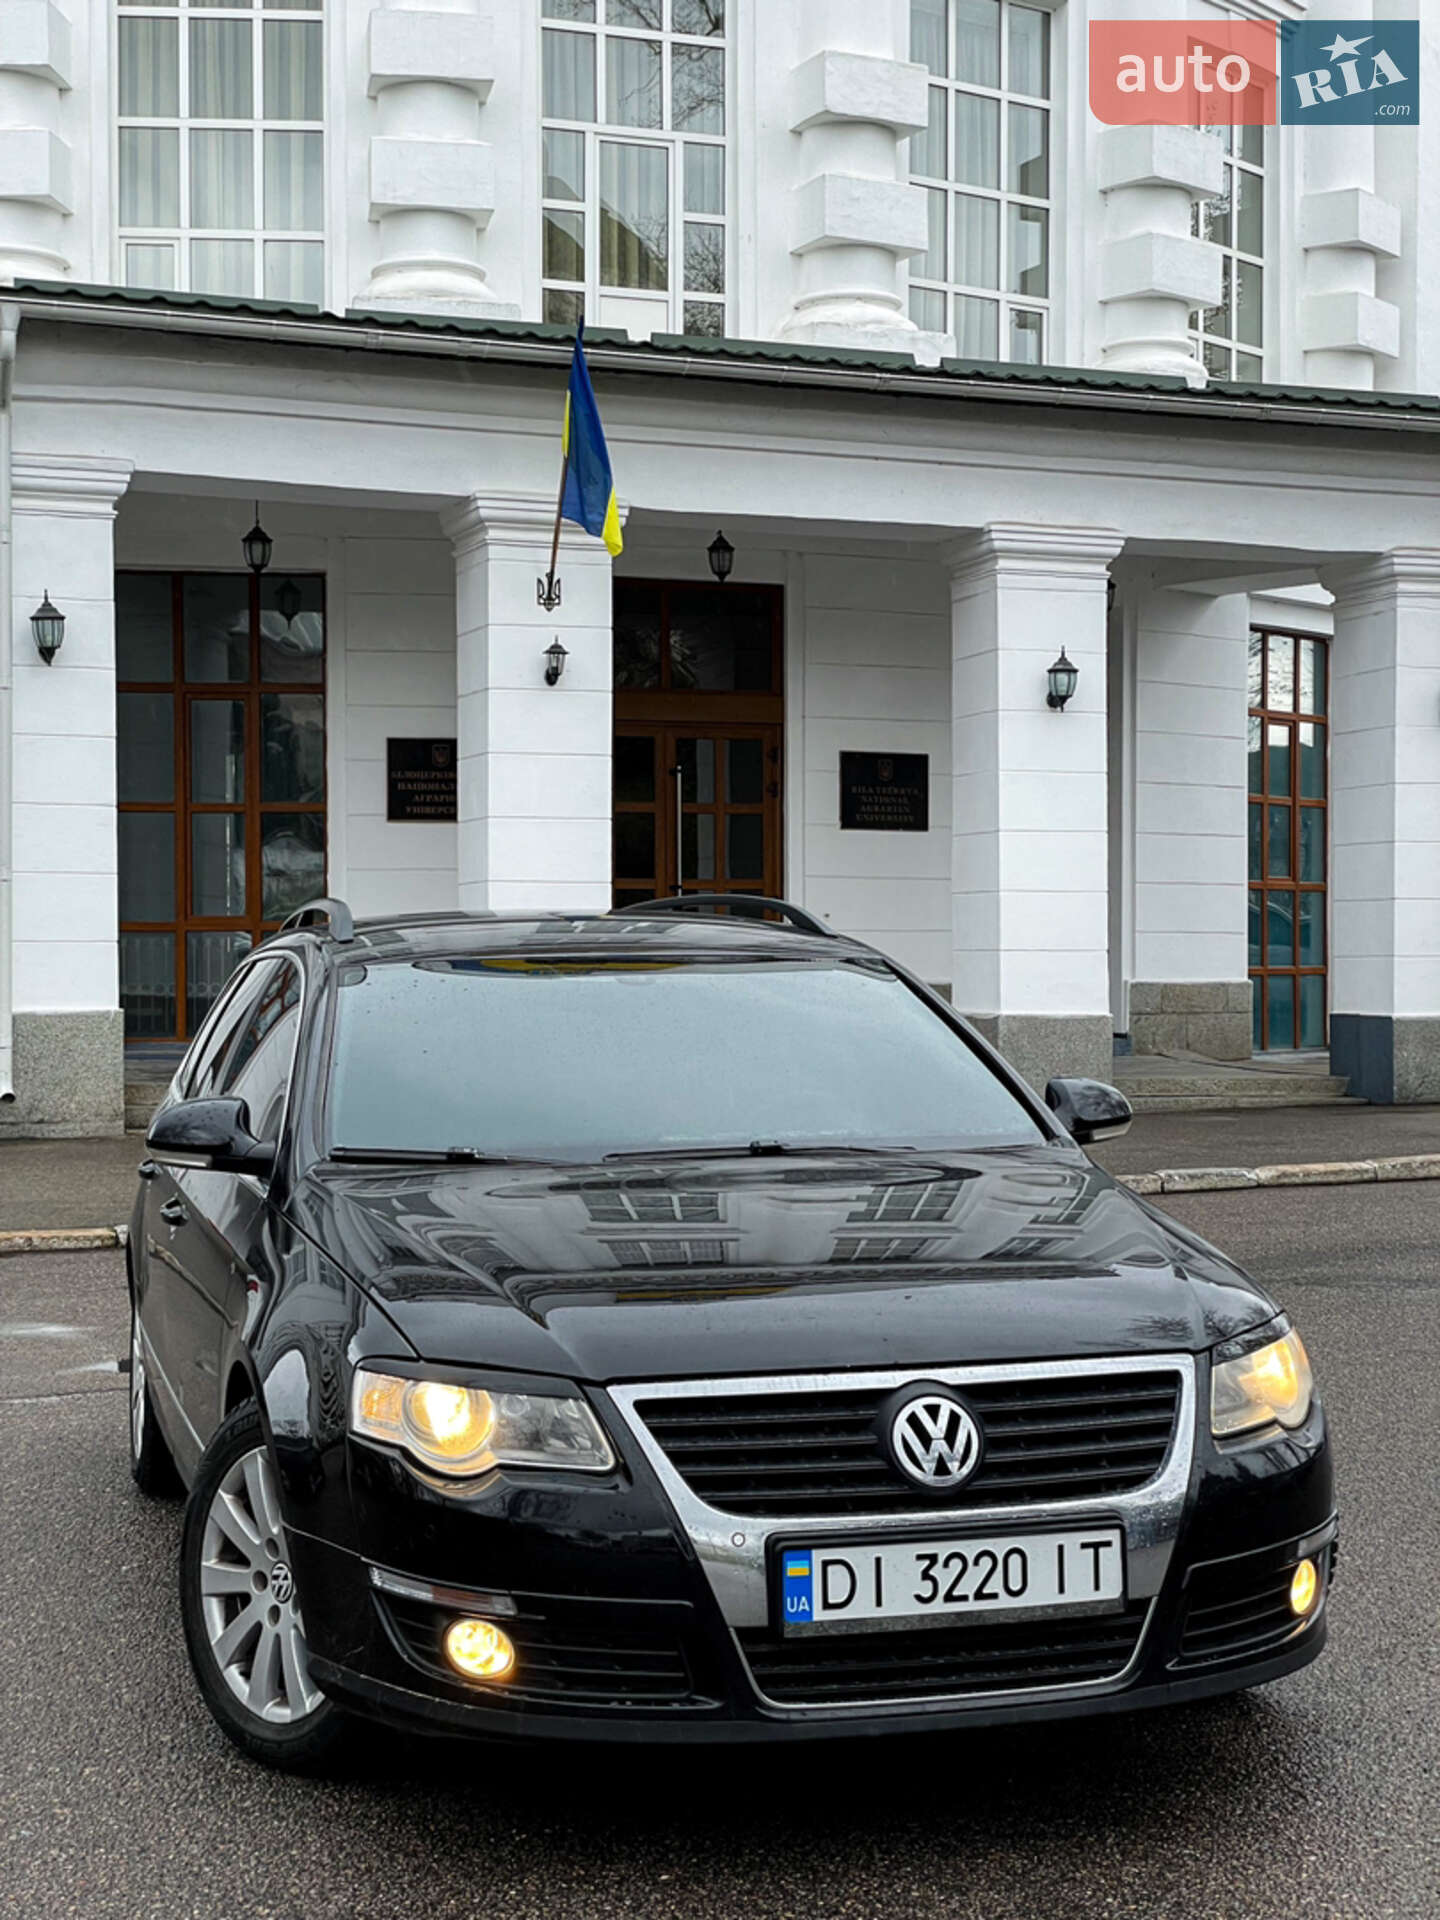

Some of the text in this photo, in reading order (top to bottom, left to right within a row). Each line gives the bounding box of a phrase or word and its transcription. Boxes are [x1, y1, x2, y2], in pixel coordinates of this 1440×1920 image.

[821, 1539, 1113, 1611] DI 3220 IT
[786, 1596, 810, 1613] UA
